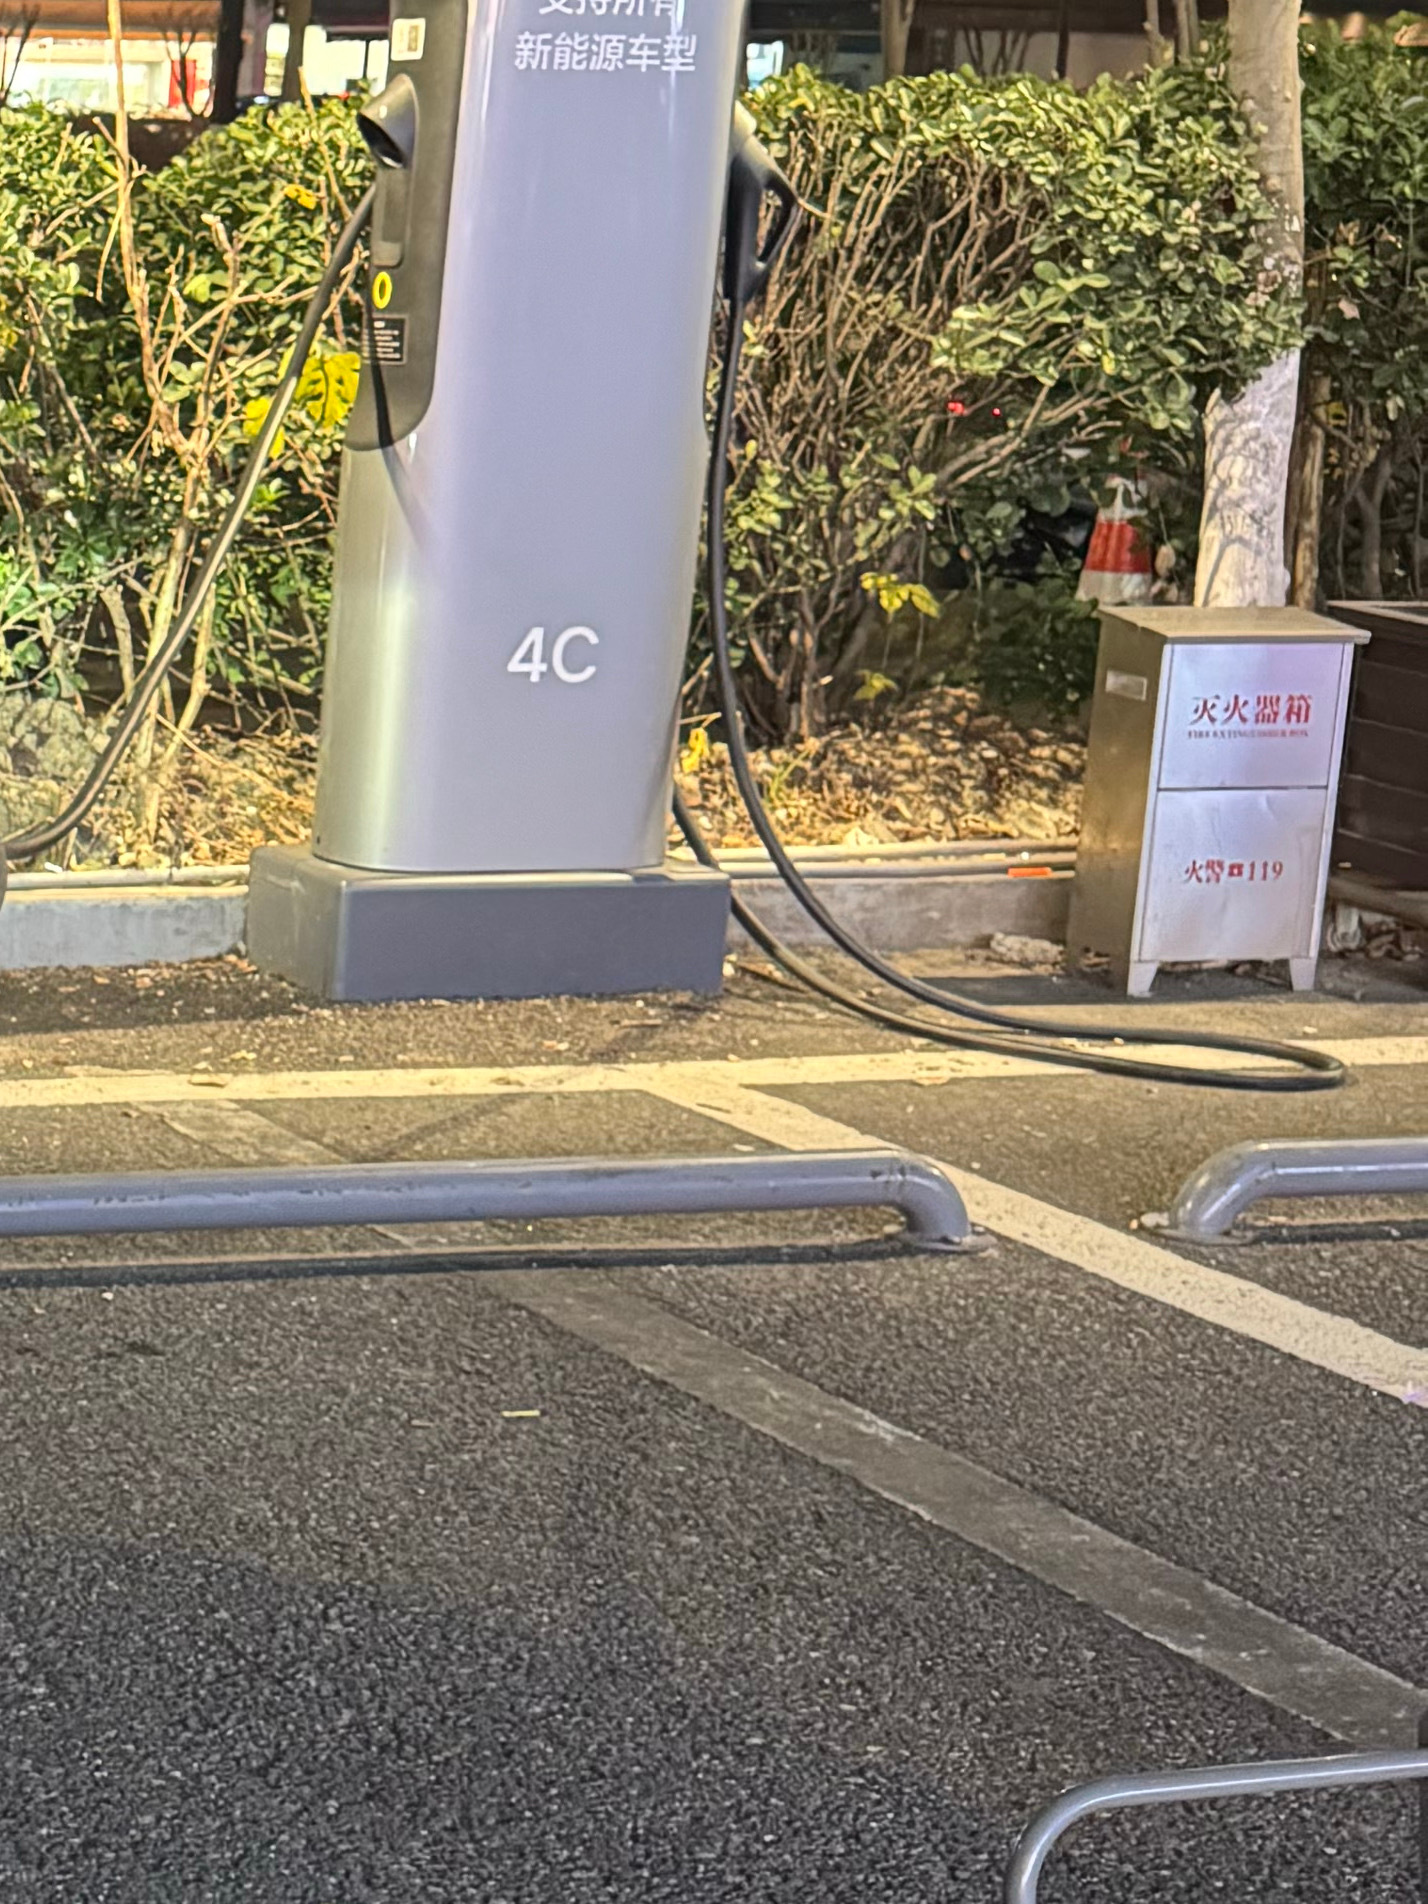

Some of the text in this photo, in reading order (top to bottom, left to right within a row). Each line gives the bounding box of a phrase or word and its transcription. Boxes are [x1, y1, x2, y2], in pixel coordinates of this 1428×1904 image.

[515, 32, 697, 72] 新能源车型
[506, 625, 599, 683] 4C
[1188, 693, 1313, 725] 灭火器箱
[1184, 859, 1283, 884] 火警 119
